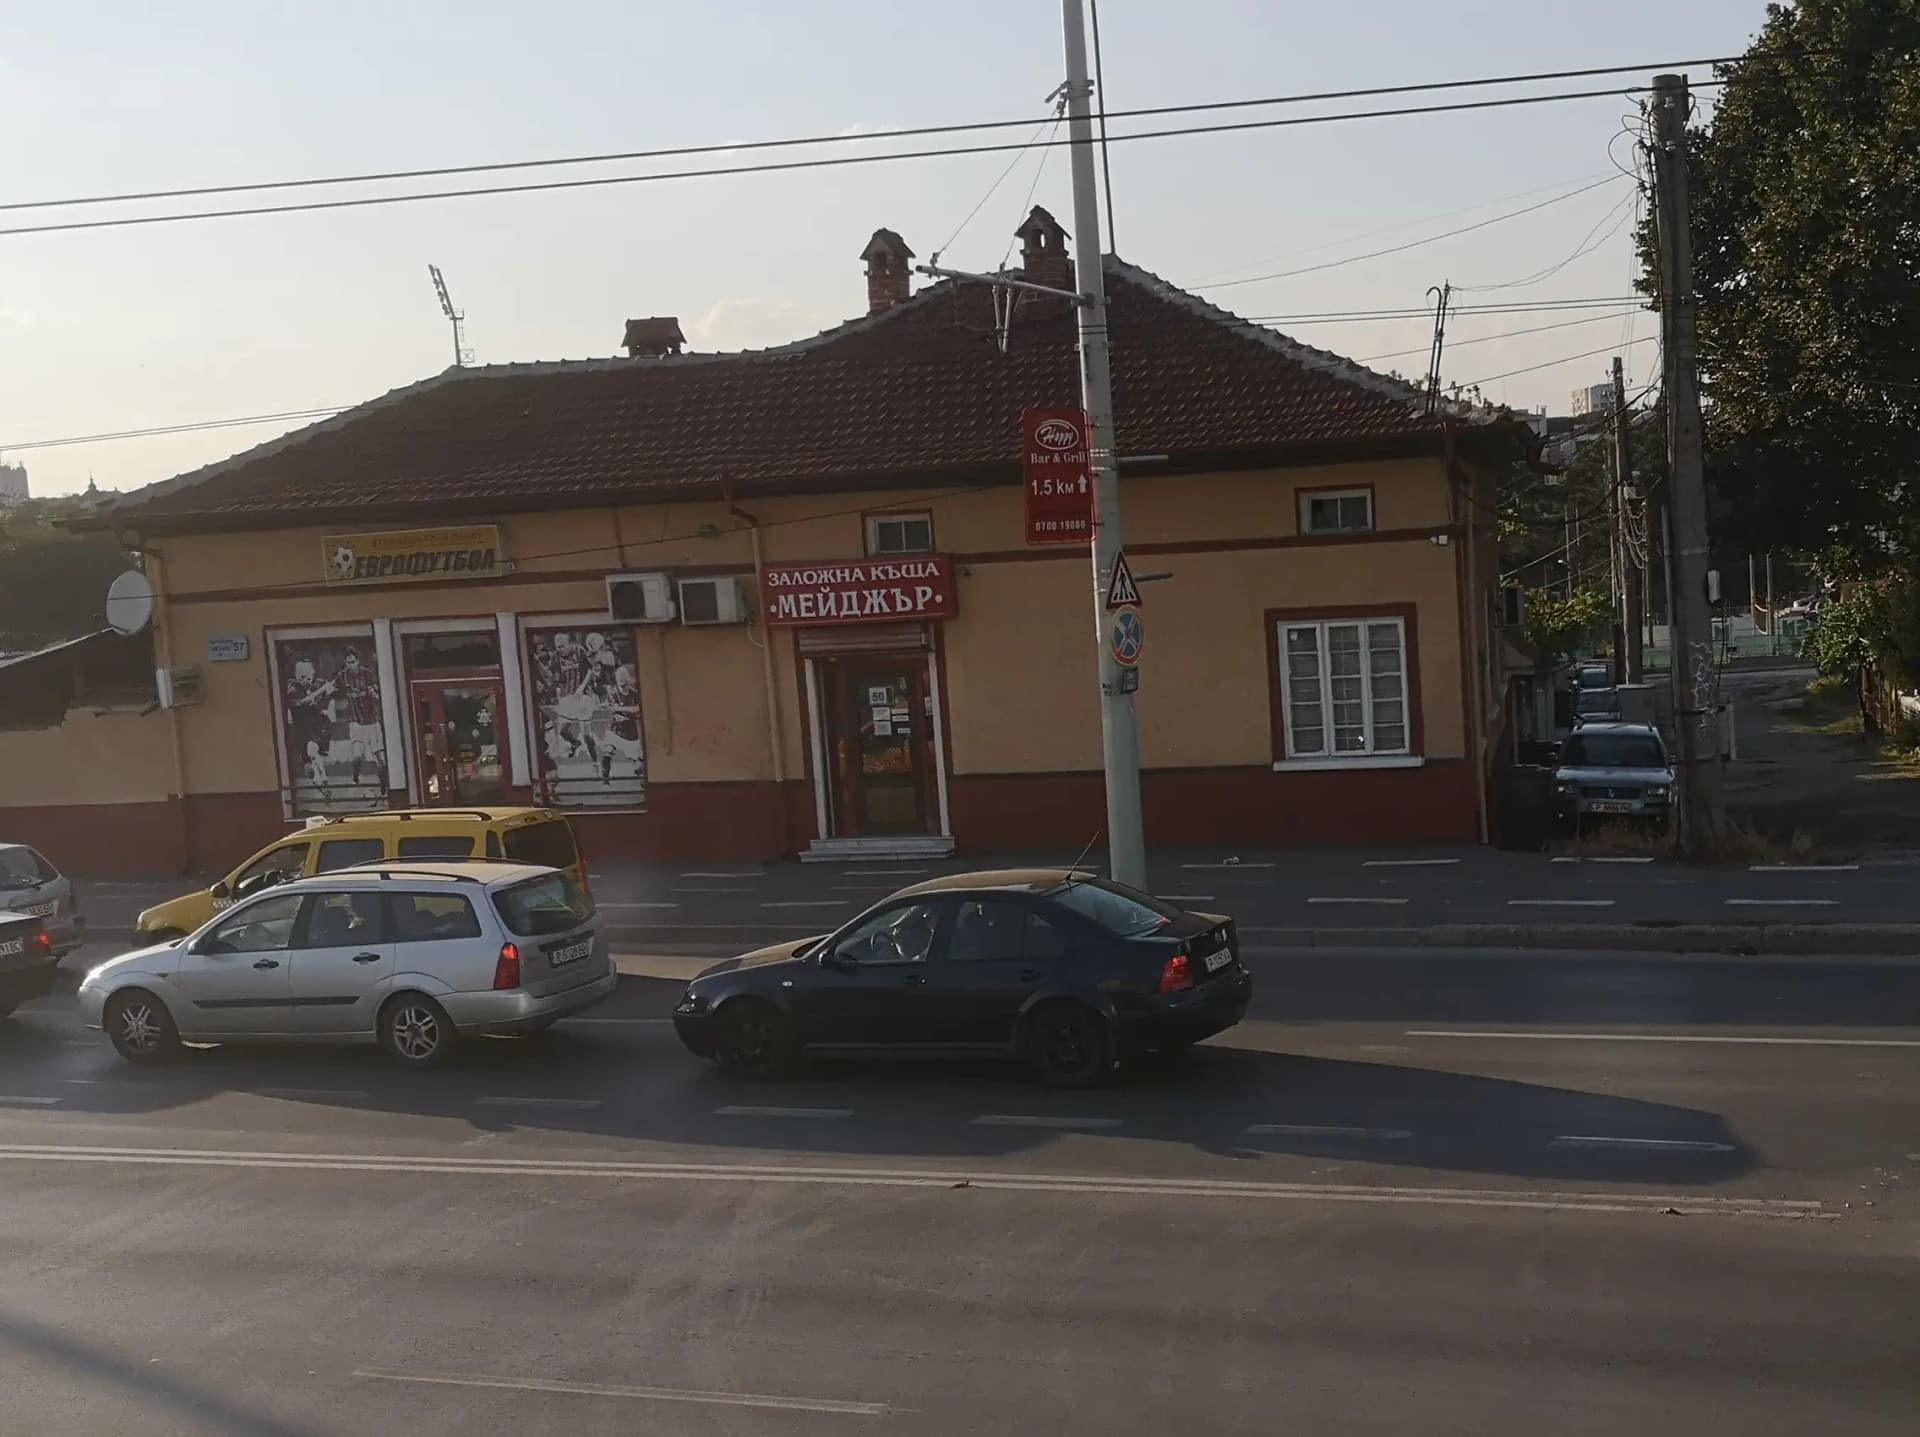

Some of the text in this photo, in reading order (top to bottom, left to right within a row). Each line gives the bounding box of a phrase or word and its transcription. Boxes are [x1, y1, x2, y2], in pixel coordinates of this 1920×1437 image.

[1031, 450, 1086, 464] Bar & Grill
[1031, 479, 1053, 496] 1.5
[354, 549, 496, 579] ЕВРОФУТБОЛ
[768, 562, 940, 587] ЗАЛОЖНА КЪЩА
[777, 586, 933, 619] МЕЙДЖЪР
